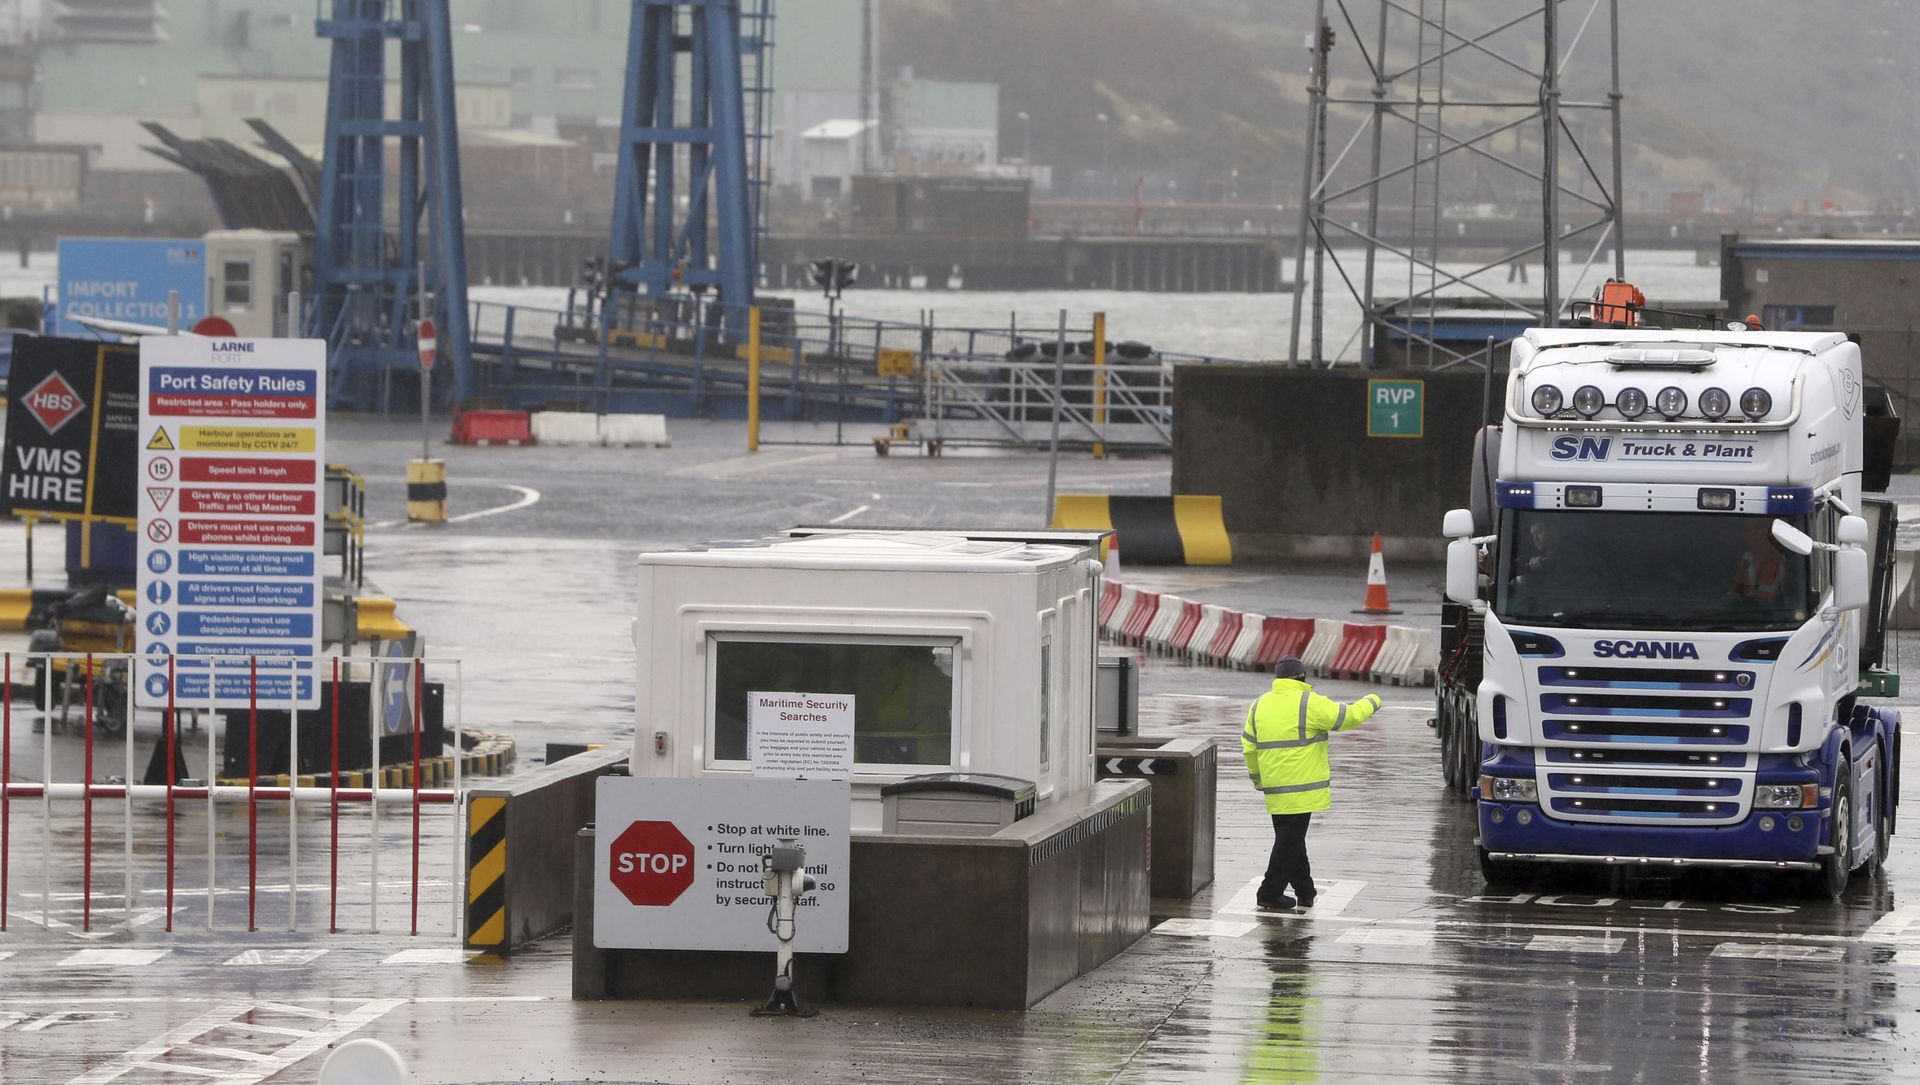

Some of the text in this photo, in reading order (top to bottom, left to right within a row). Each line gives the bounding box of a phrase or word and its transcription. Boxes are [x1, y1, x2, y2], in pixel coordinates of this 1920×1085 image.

[67, 281, 139, 298] IMPORT
[187, 303, 196, 319] 1
[212, 343, 254, 352] LARNE
[161, 375, 305, 392] Port Safety Rules
[34, 392, 73, 410] HBS
[1376, 388, 1415, 404] RVP
[157, 398, 201, 407] Restricted
[231, 400, 252, 408] Pass
[254, 401, 285, 409] holders
[288, 402, 308, 410] only.
[1391, 413, 1398, 428] 1
[199, 430, 233, 438] Harbour
[236, 431, 280, 440] operations
[197, 440, 240, 449] monitored
[241, 441, 252, 449] by
[1550, 436, 1754, 462] SN Truck & Plant
[16, 446, 82, 475] VMS
[154, 463, 286, 476] 15 Speed limit 15mph
[9, 474, 83, 503] HIRE
[192, 492, 211, 500] Give
[213, 493, 230, 501] Way
[268, 494, 303, 502] Harbour
[244, 504, 260, 513] Tug
[262, 504, 296, 512] Masters
[188, 522, 218, 531] Drivers
[277, 524, 305, 532] mobile
[201, 534, 291, 544] phones whilst driving
[188, 553, 208, 563] High
[210, 553, 244, 563] visibility
[246, 554, 281, 564] clothing
[205, 564, 216, 572] be
[241, 565, 250, 573] at
[252, 565, 262, 573] all
[264, 565, 287, 573] times
[188, 584, 200, 592] All
[202, 584, 230, 593] drivers
[283, 586, 303, 594] road
[194, 595, 297, 605] signs and road markings
[200, 615, 250, 623] Pedestrians
[200, 627, 290, 636] designated walkways
[246, 648, 294, 656] passengers
[1594, 640, 1699, 660] SCANIA
[760, 699, 848, 711] Maritime Security
[780, 712, 827, 721] Searches
[717, 823, 830, 837] Stop at white line.
[717, 843, 744, 854] Turn
[618, 853, 687, 874] STOP
[717, 862, 735, 873] Do
[739, 863, 758, 873] not
[820, 883, 835, 891] so
[716, 893, 730, 905] by
[793, 895, 819, 907] taff.
